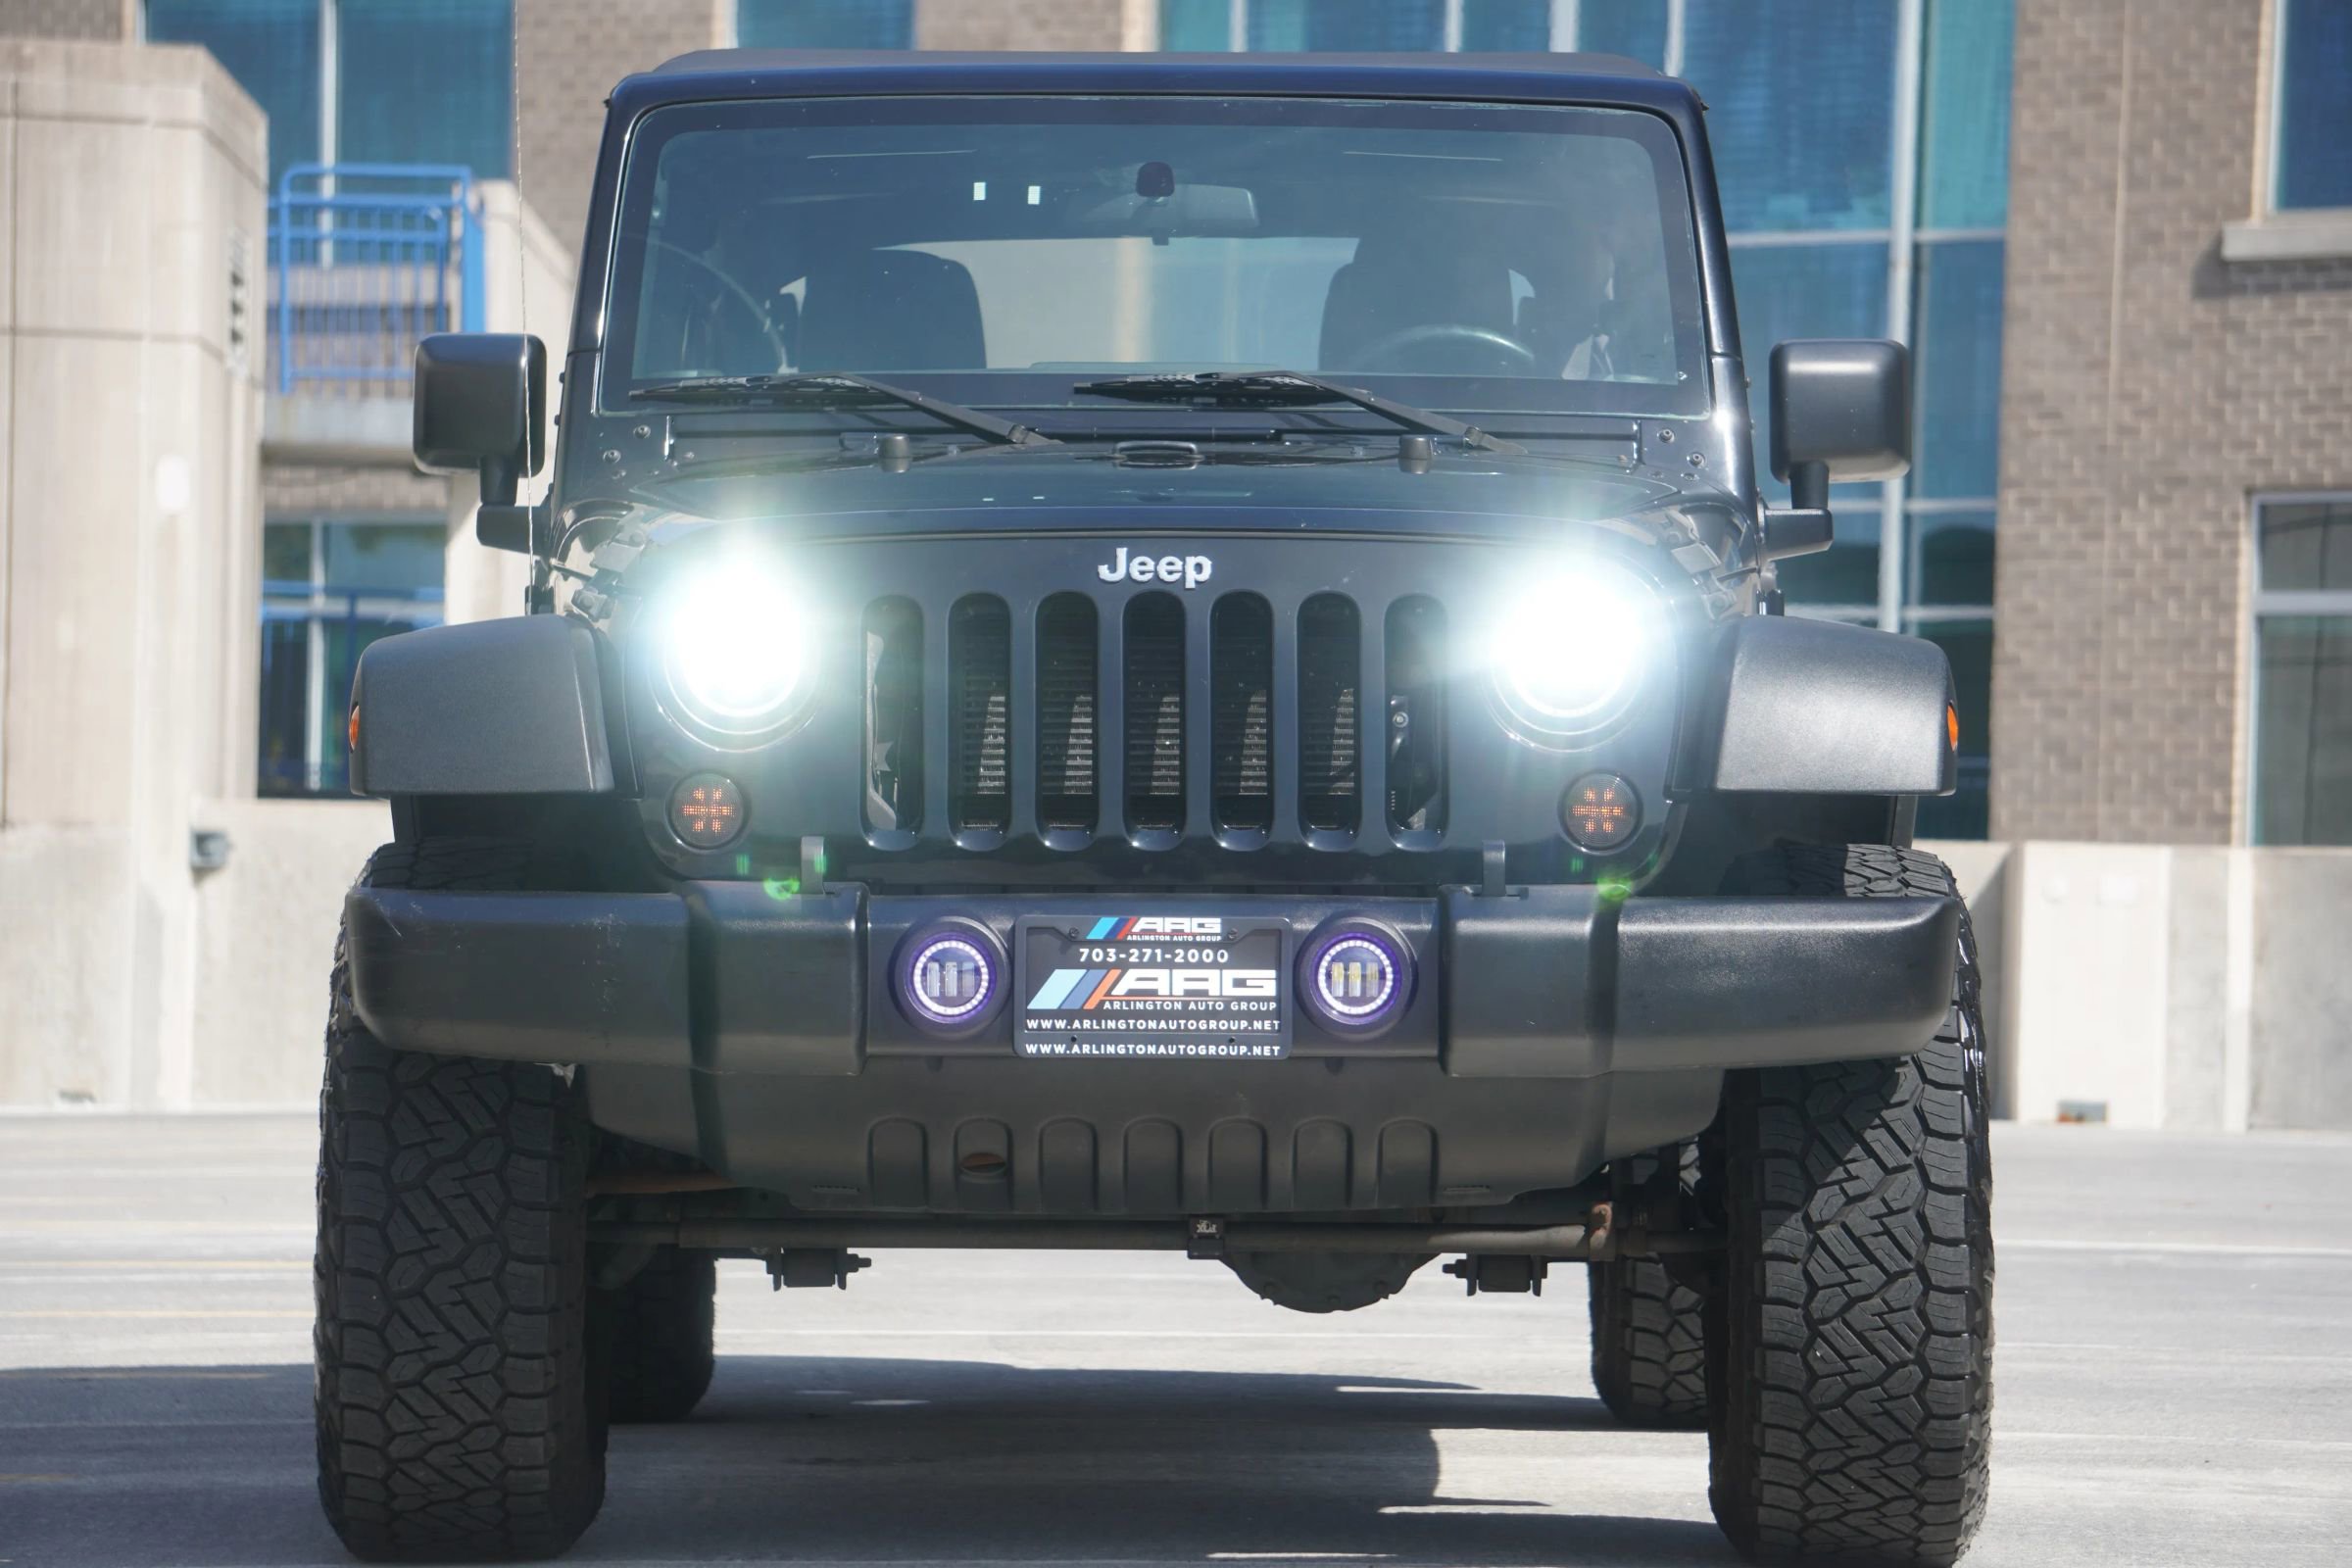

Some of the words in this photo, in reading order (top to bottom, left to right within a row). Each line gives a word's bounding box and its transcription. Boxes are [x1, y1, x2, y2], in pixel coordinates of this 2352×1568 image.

[1098, 547, 1212, 589] Jeep
[1079, 949, 1228, 962] 703-271-2000
[1103, 1001, 1182, 1010] ARLINGTON
[1189, 1002, 1224, 1010] AUTO
[1231, 1002, 1277, 1011] GROUP
[1026, 1019, 1281, 1030] WWW.ARLINGTONAUTOGROUP.NET
[1025, 1044, 1281, 1055] WWW.ARLINGTONAUTOGROUP.NET
